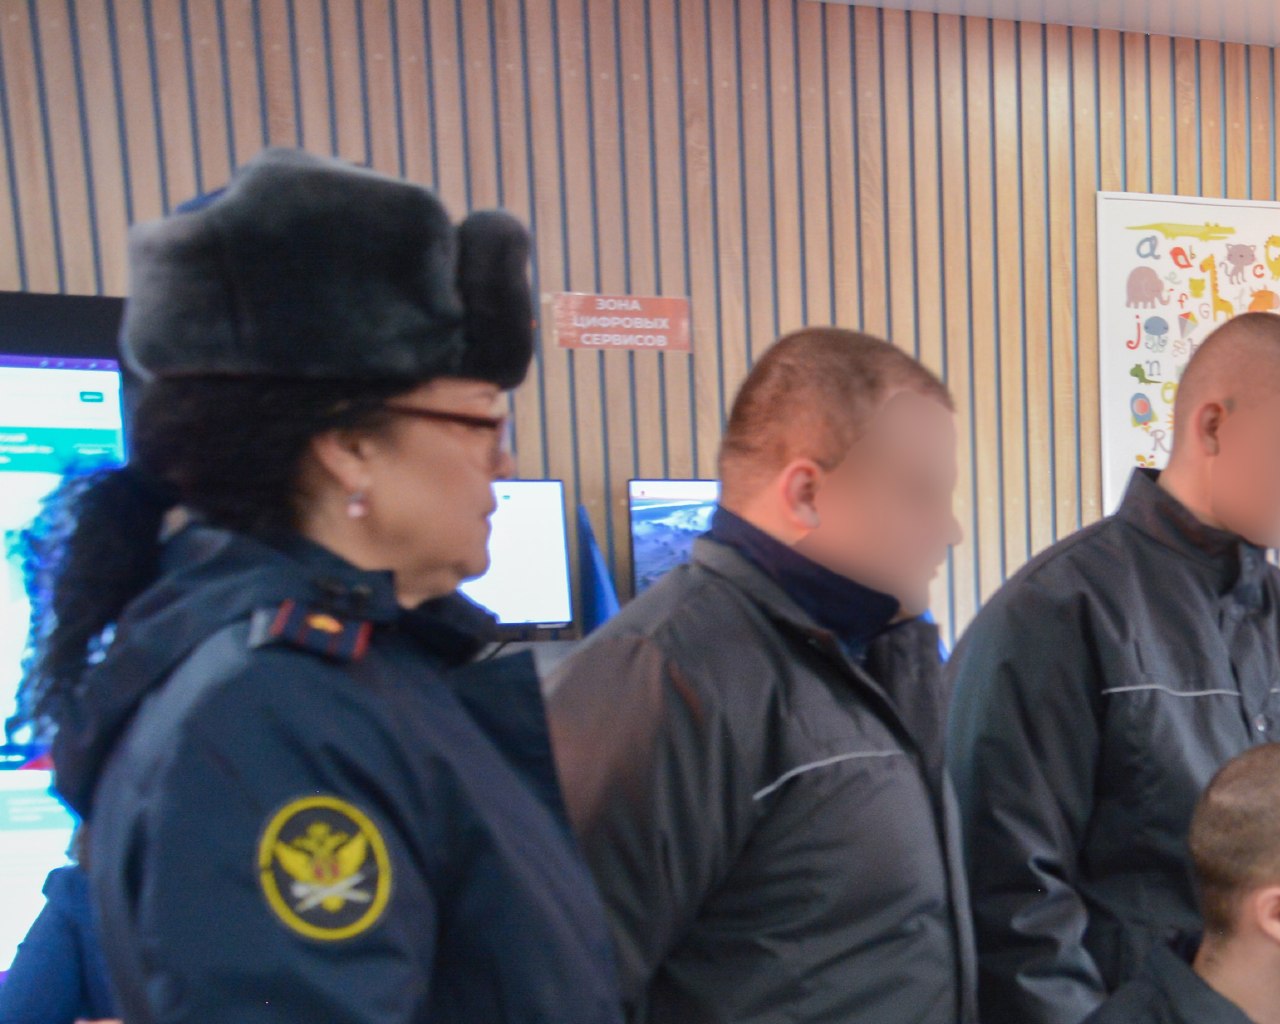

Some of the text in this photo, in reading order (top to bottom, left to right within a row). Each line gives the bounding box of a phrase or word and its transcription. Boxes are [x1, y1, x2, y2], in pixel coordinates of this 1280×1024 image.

[595, 299, 642, 311] ЗОНА
[572, 316, 670, 329] ЦИФРОВЫХ
[580, 333, 668, 346] СЕРВИСОВ
